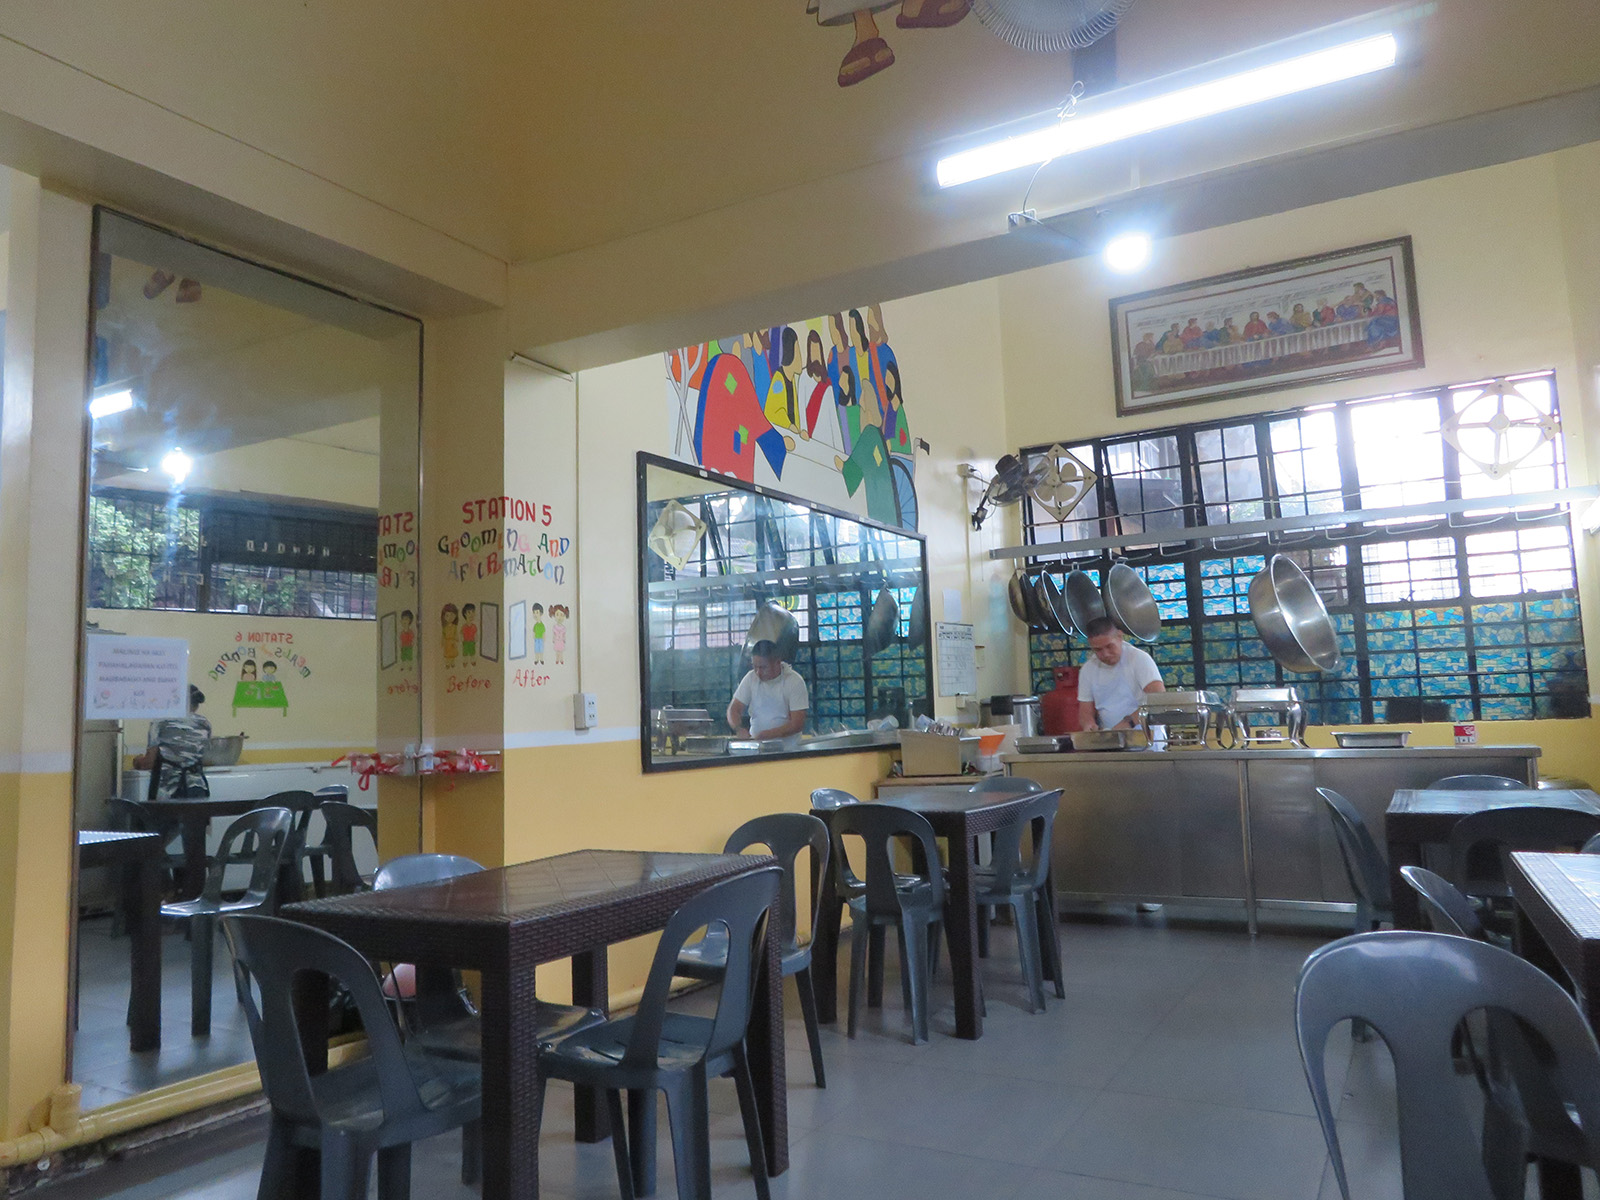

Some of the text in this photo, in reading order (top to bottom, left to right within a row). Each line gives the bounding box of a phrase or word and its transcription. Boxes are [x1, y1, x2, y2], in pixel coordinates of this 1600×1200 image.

[462, 496, 552, 526] STATION 5
[447, 674, 491, 693] Before
[513, 669, 550, 688] After
